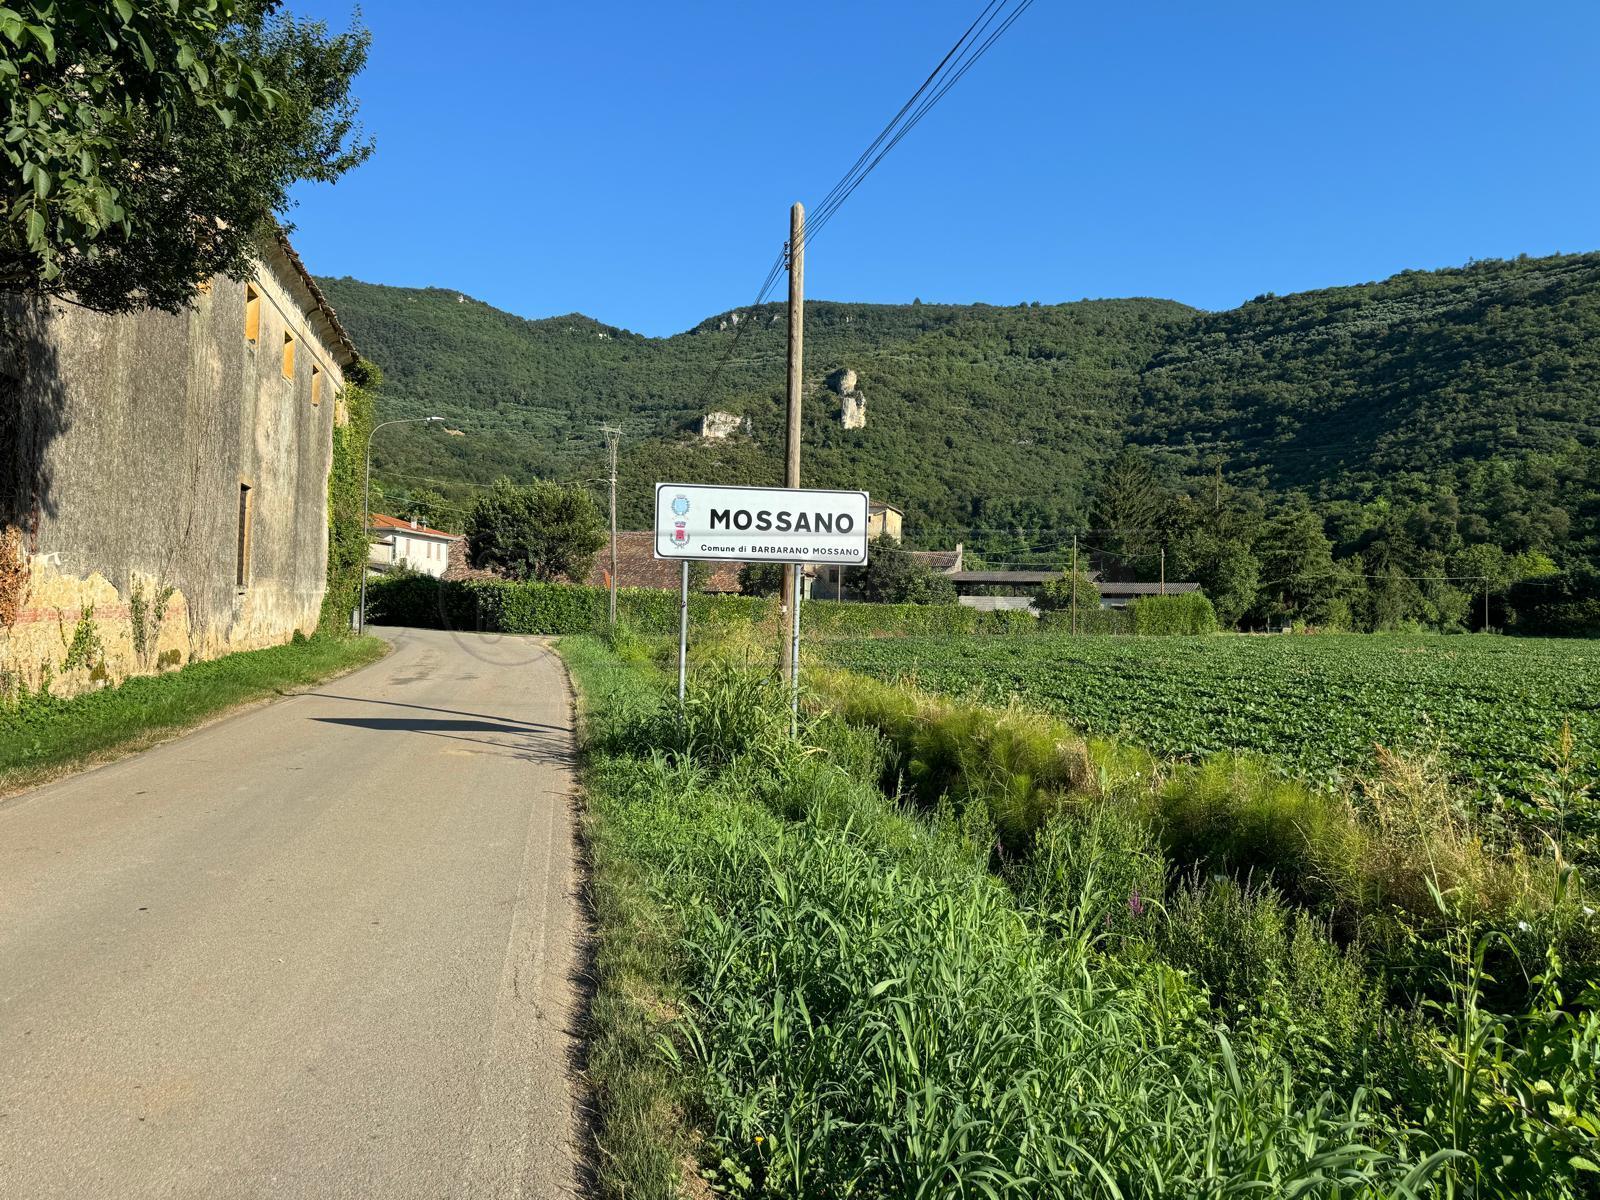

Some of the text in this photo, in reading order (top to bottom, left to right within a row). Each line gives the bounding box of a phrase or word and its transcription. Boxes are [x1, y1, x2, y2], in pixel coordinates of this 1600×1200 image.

[709, 508, 854, 534] MOSSANO
[700, 544, 860, 556] Comune di BARBARANO MOSSANO
